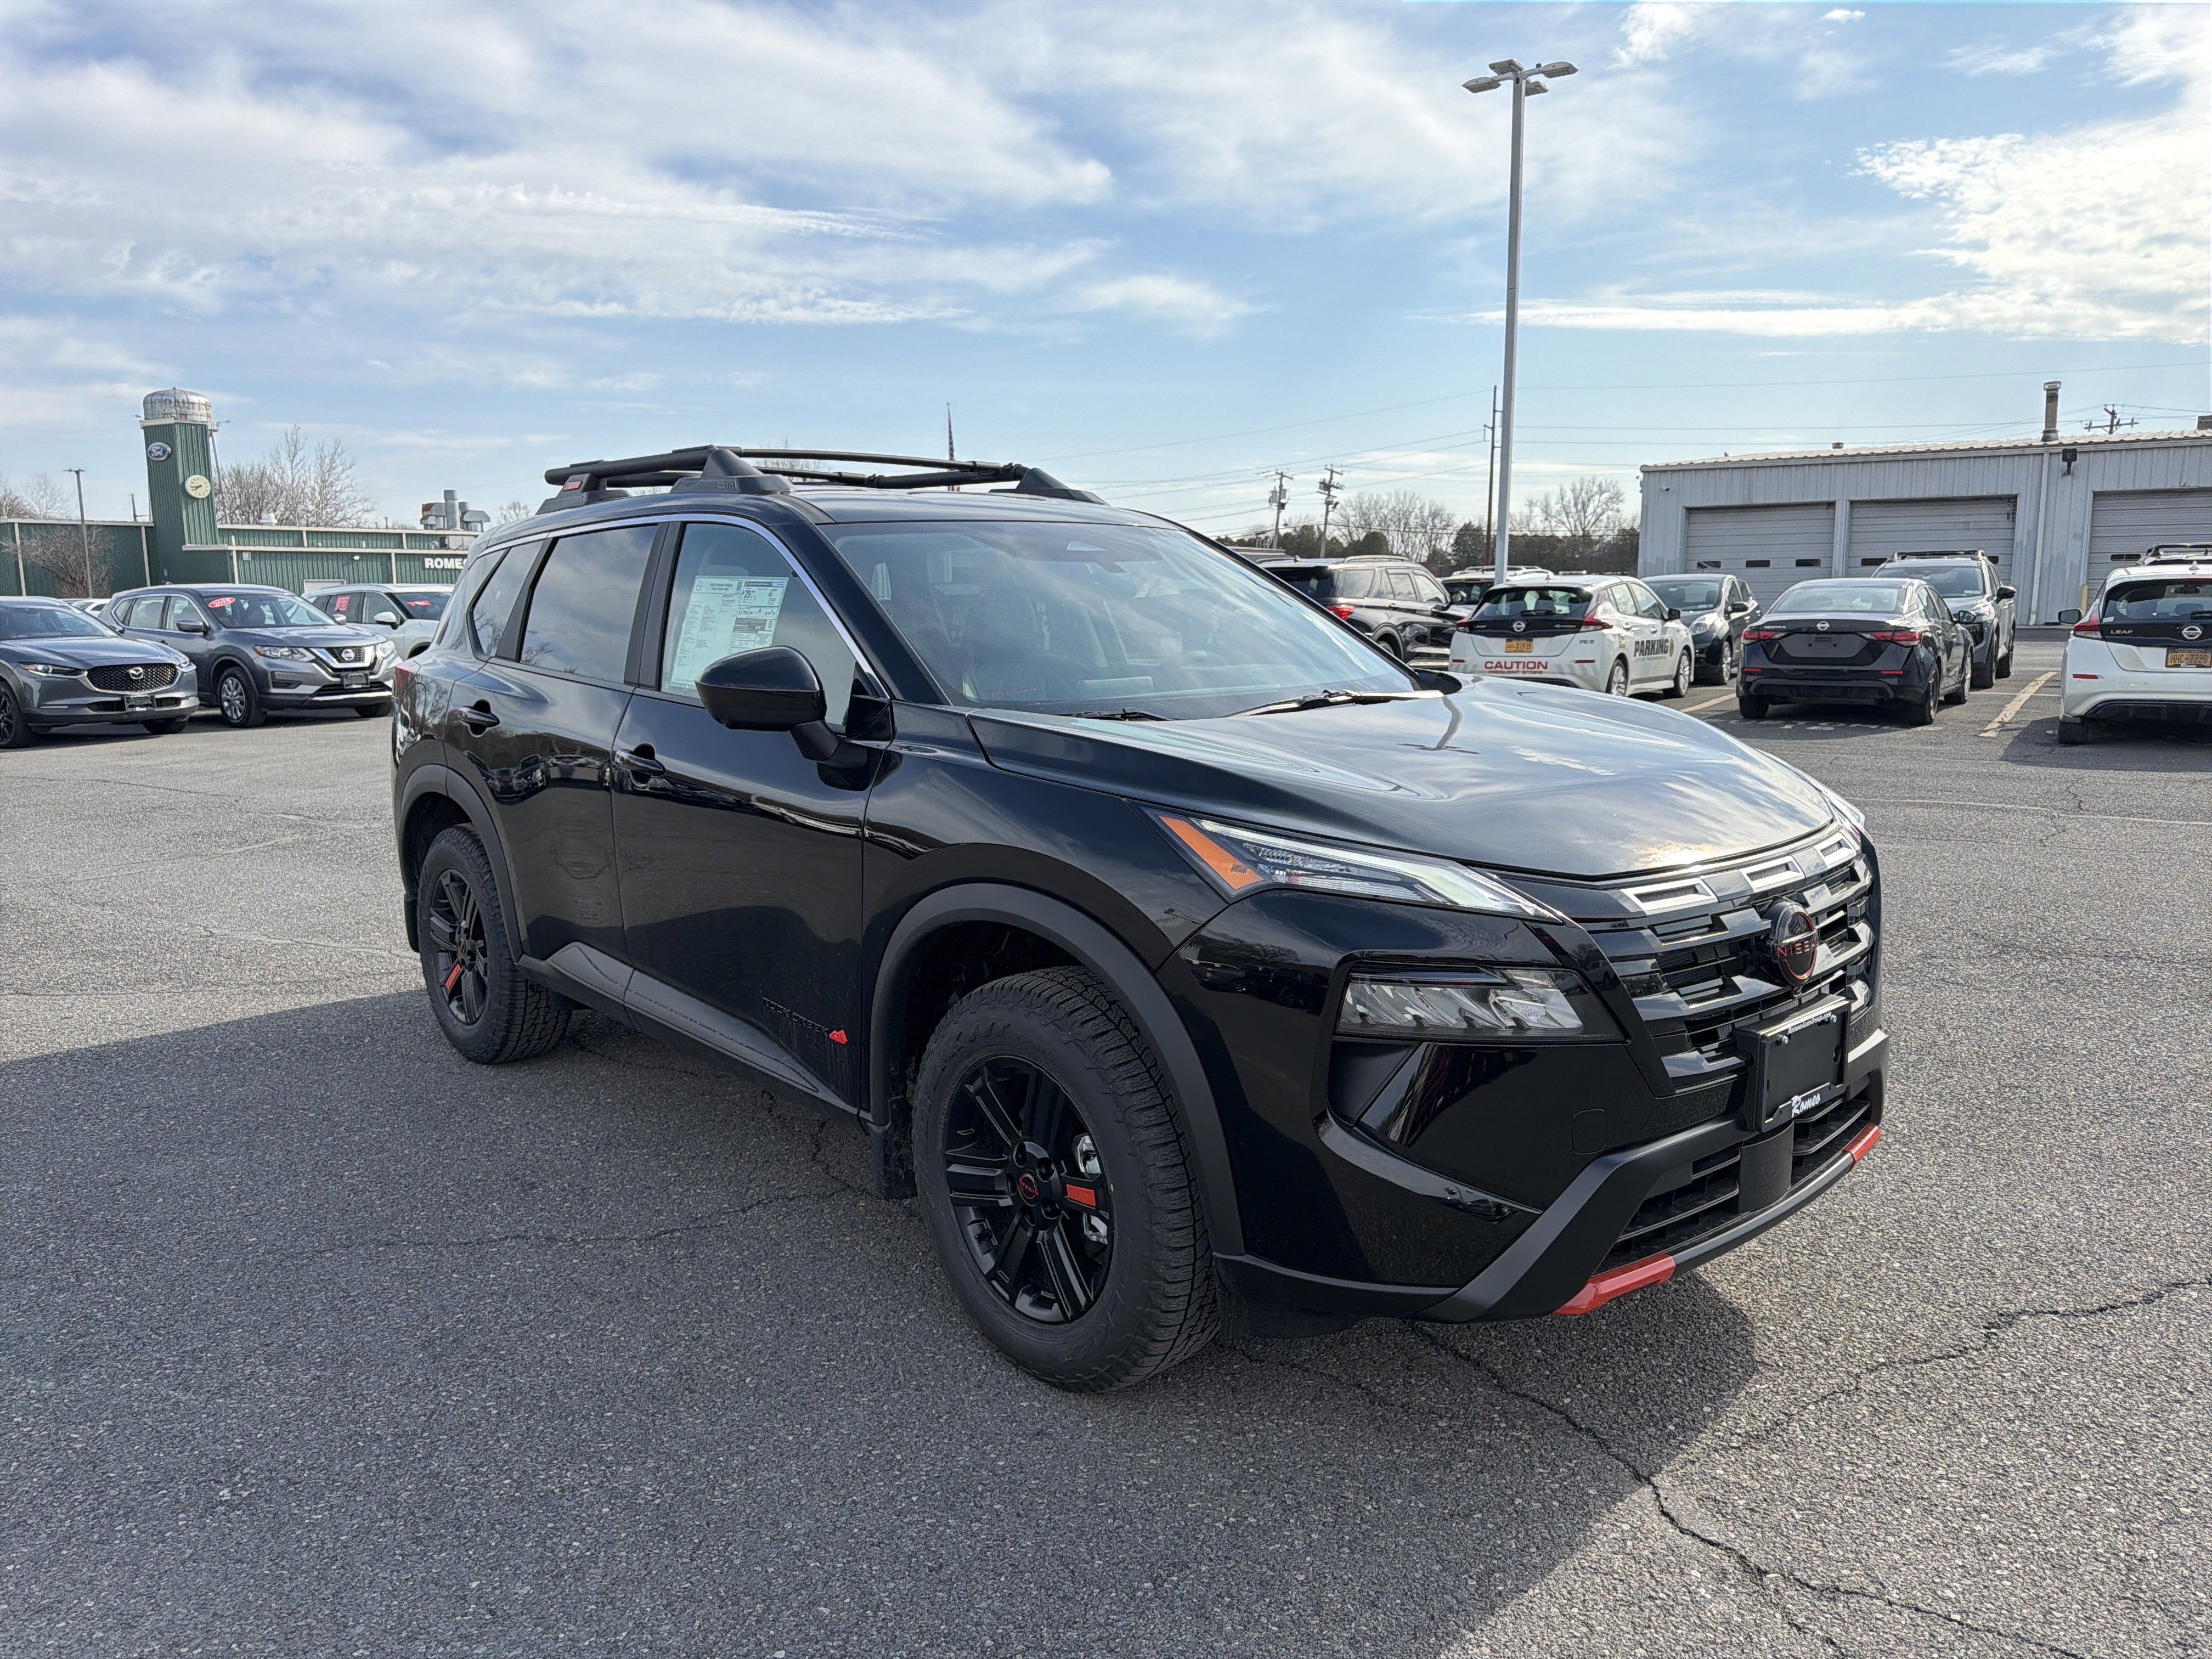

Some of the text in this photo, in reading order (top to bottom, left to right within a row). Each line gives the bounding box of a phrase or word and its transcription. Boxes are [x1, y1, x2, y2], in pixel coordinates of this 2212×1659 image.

[151, 446, 163, 456] Ford
[1634, 639, 1669, 657] PARKING
[1484, 661, 1548, 670] CAUTION
[1791, 1093, 1821, 1119] Romeo
